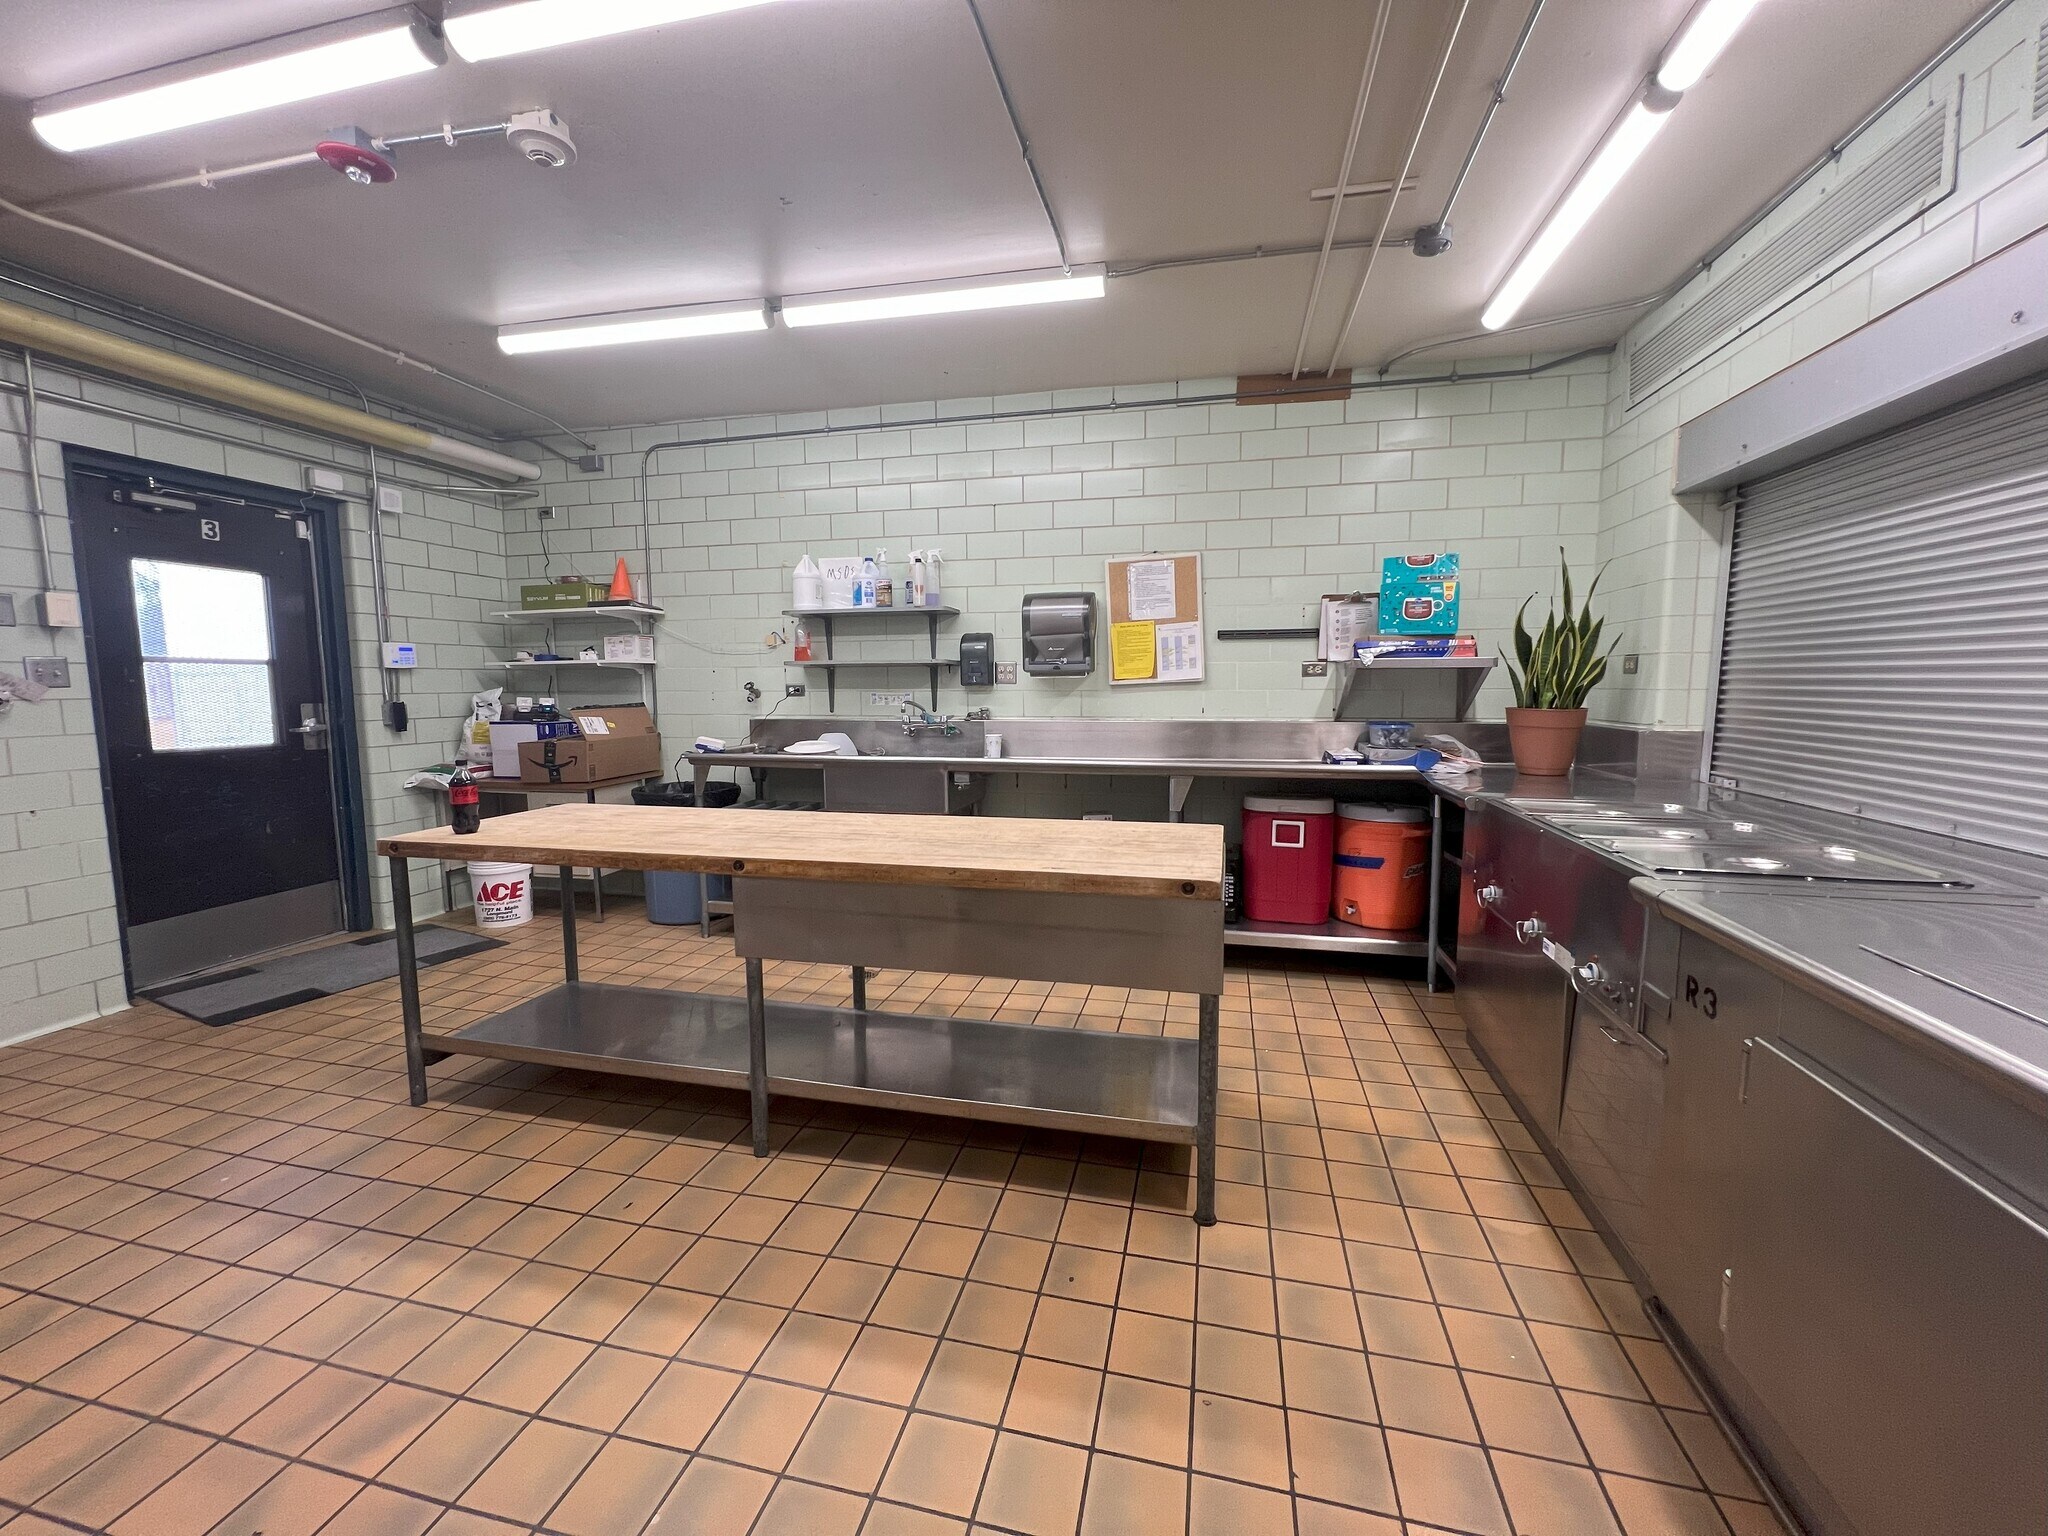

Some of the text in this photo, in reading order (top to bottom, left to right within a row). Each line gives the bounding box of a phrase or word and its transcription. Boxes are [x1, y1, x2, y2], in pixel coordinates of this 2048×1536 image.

[204, 521, 218, 539] 3
[827, 566, 854, 580] MSDS
[477, 880, 524, 902] ACE
